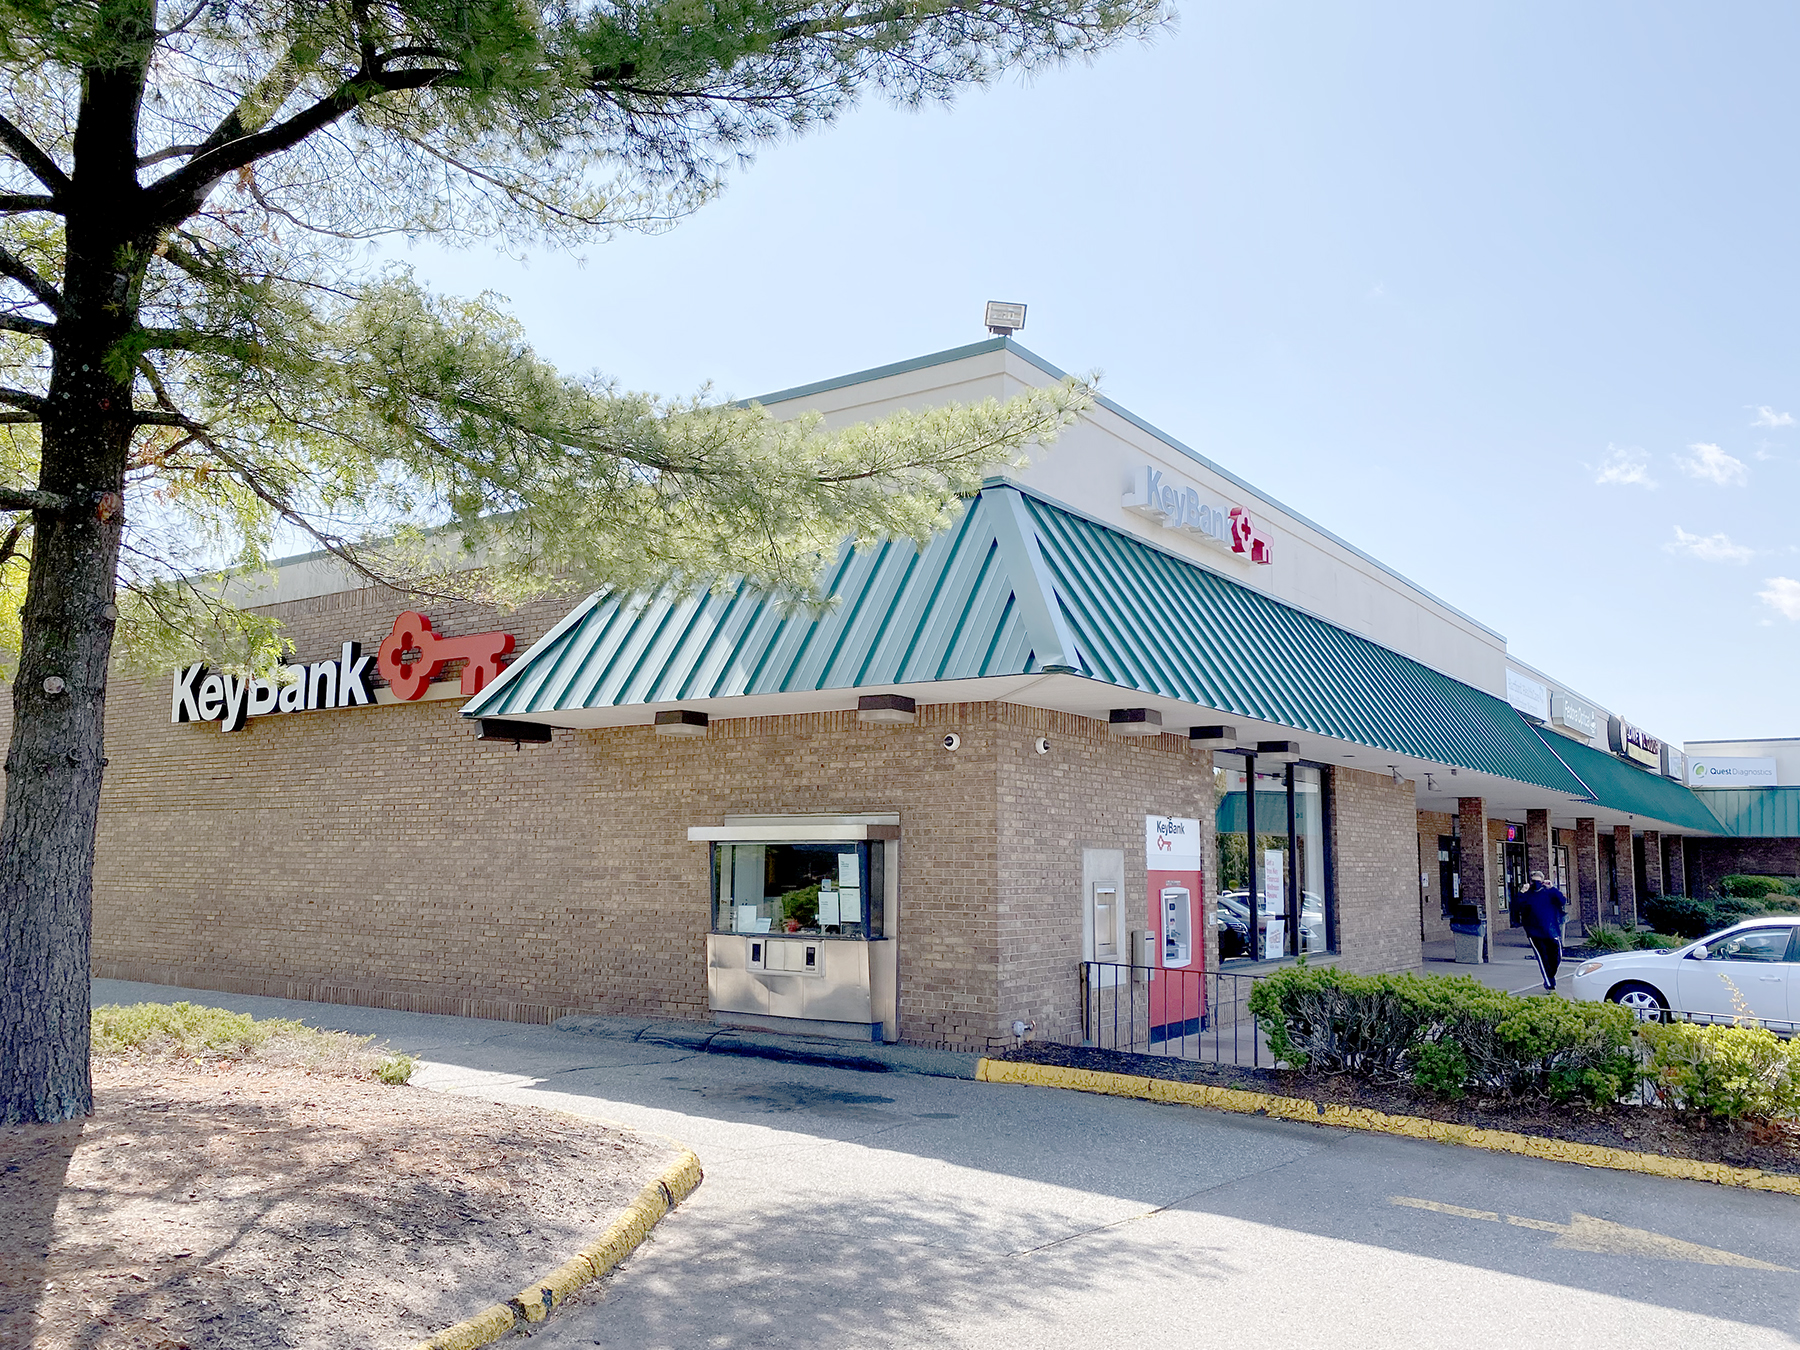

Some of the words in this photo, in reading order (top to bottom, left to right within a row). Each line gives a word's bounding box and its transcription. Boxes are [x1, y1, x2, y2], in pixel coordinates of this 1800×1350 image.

[1147, 465, 1234, 546] KeyBank
[1710, 767, 1732, 775] Quest
[1732, 768, 1773, 777] Diagnostics
[1156, 820, 1185, 836] KeyBank
